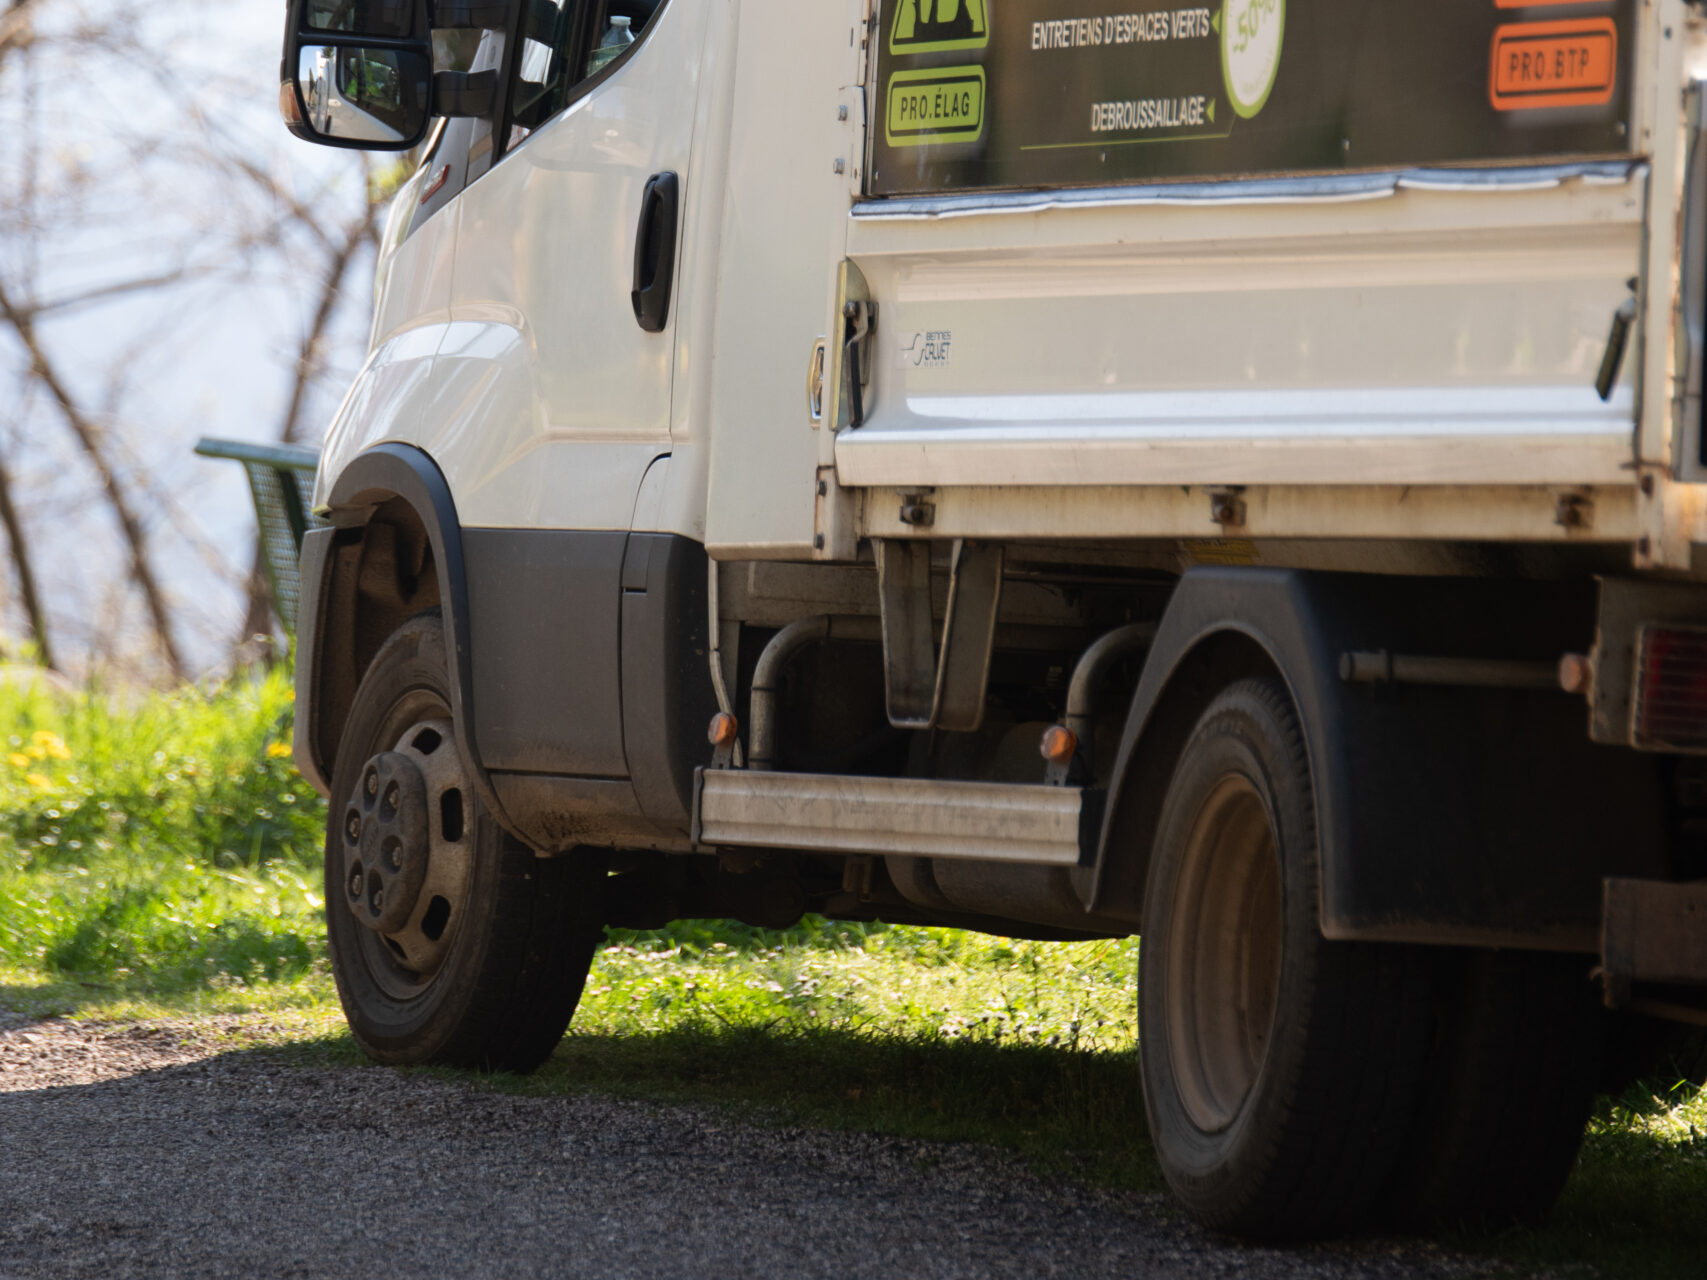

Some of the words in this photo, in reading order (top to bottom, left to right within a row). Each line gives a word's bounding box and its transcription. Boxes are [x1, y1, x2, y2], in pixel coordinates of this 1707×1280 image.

[1032, 17, 1103, 50] ENTRETIENS
[1104, 11, 1169, 45] D'ESPACES
[1170, 7, 1210, 39] VERTS
[1509, 47, 1591, 82] PRO.BTP
[900, 87, 970, 121] PRO.ÉLAG
[1091, 96, 1206, 132] DEBROUSSAILLAGE
